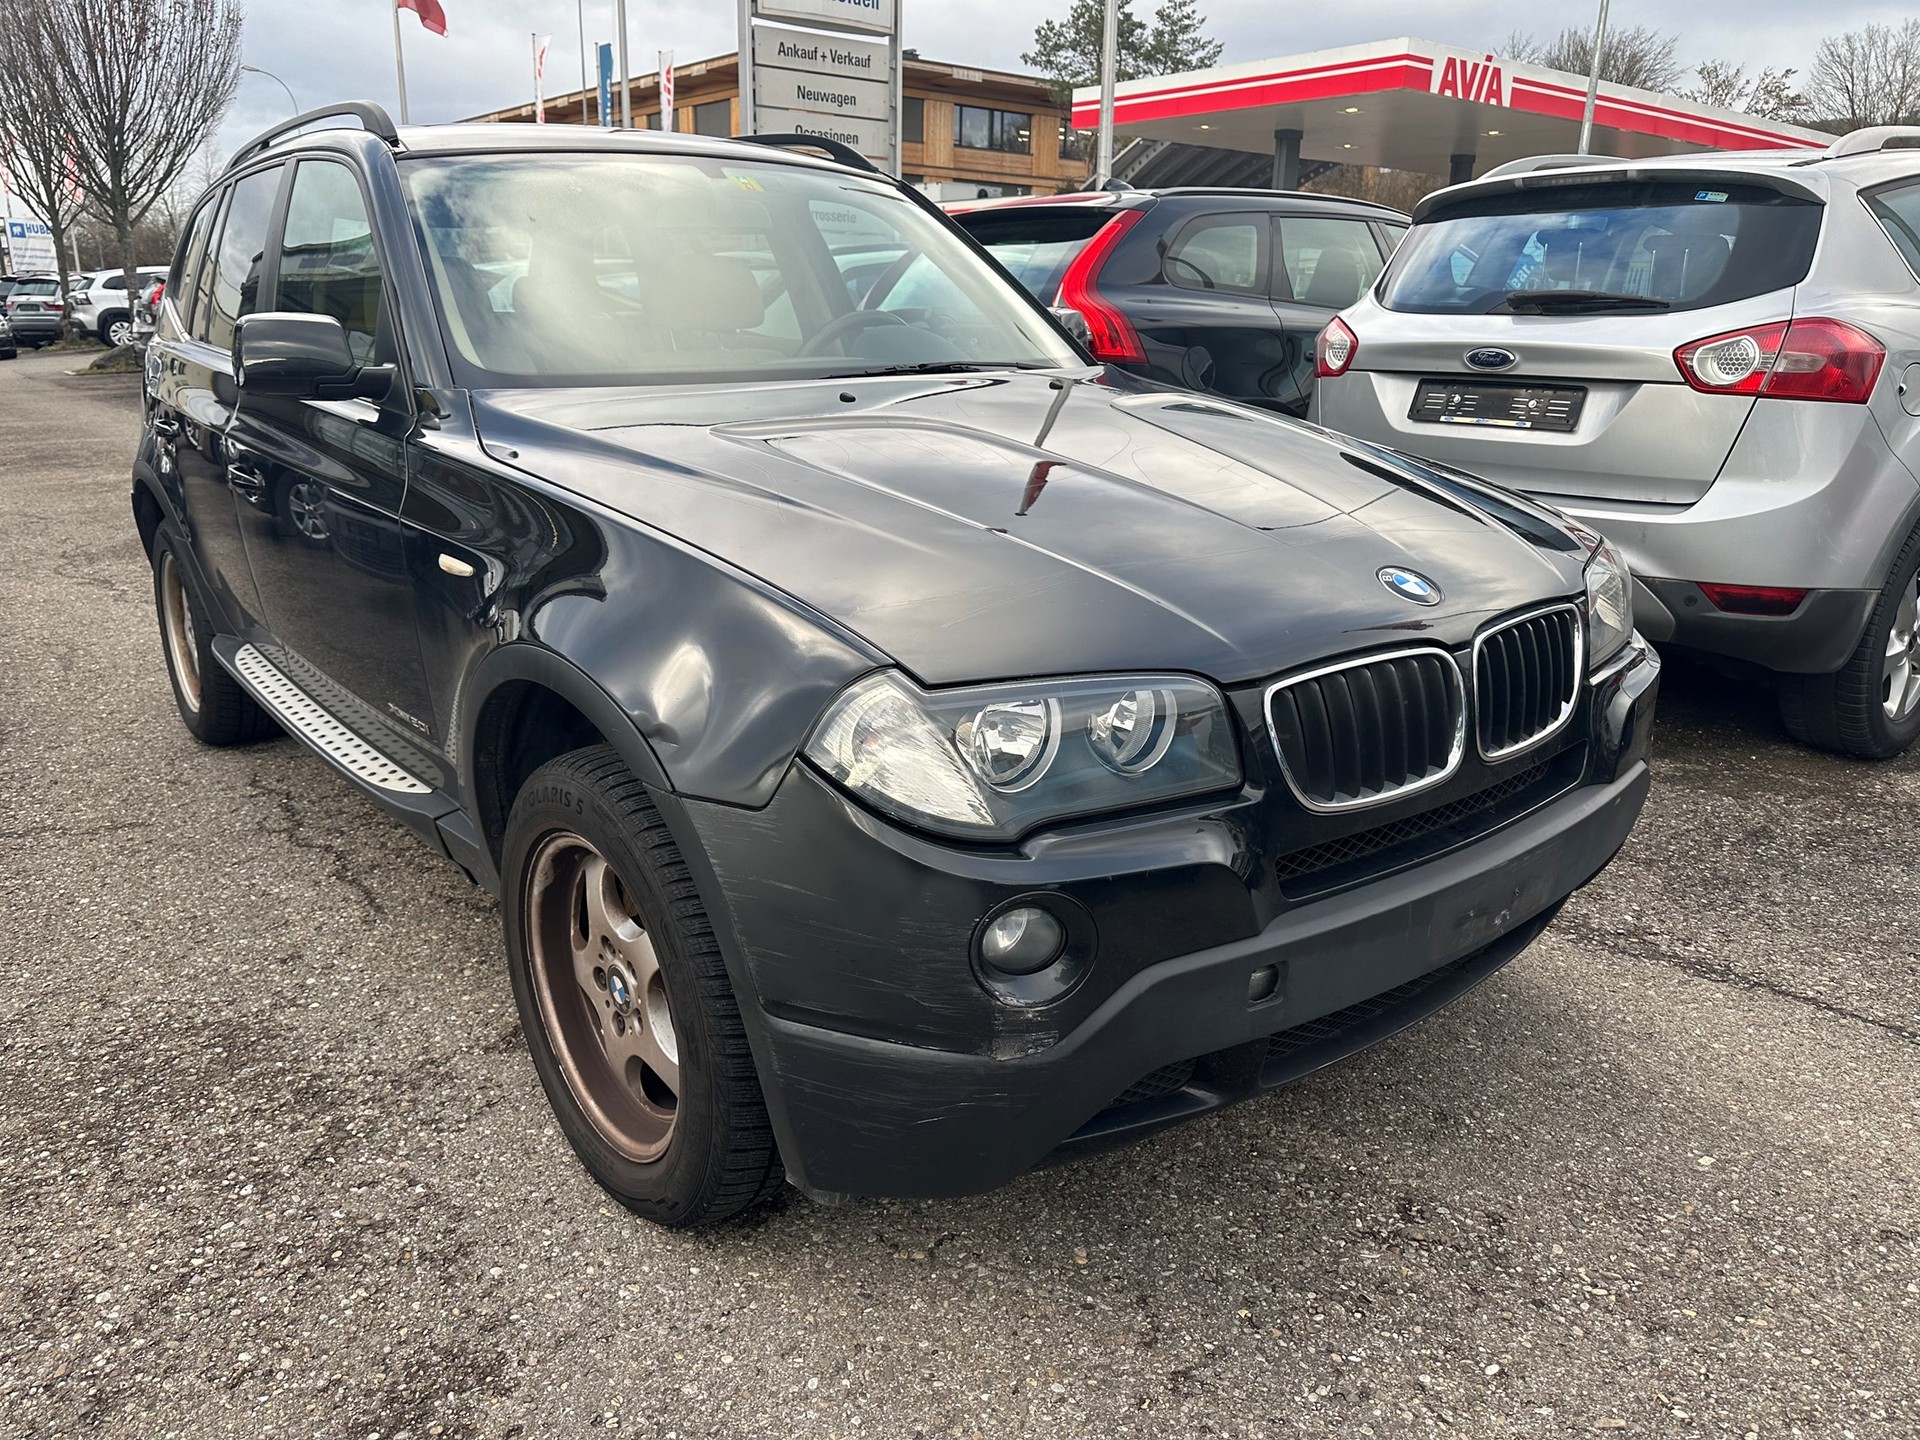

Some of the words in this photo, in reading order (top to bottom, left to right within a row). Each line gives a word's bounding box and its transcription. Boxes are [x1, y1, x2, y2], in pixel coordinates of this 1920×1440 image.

[777, 41, 818, 61] Ankauf
[820, 52, 828, 62] +
[829, 48, 872, 69] Verkauf
[1437, 54, 1503, 107] AVIA
[797, 85, 857, 107] Neuwagen
[1475, 351, 1503, 365] Ford
[521, 785, 572, 813] POLARIS
